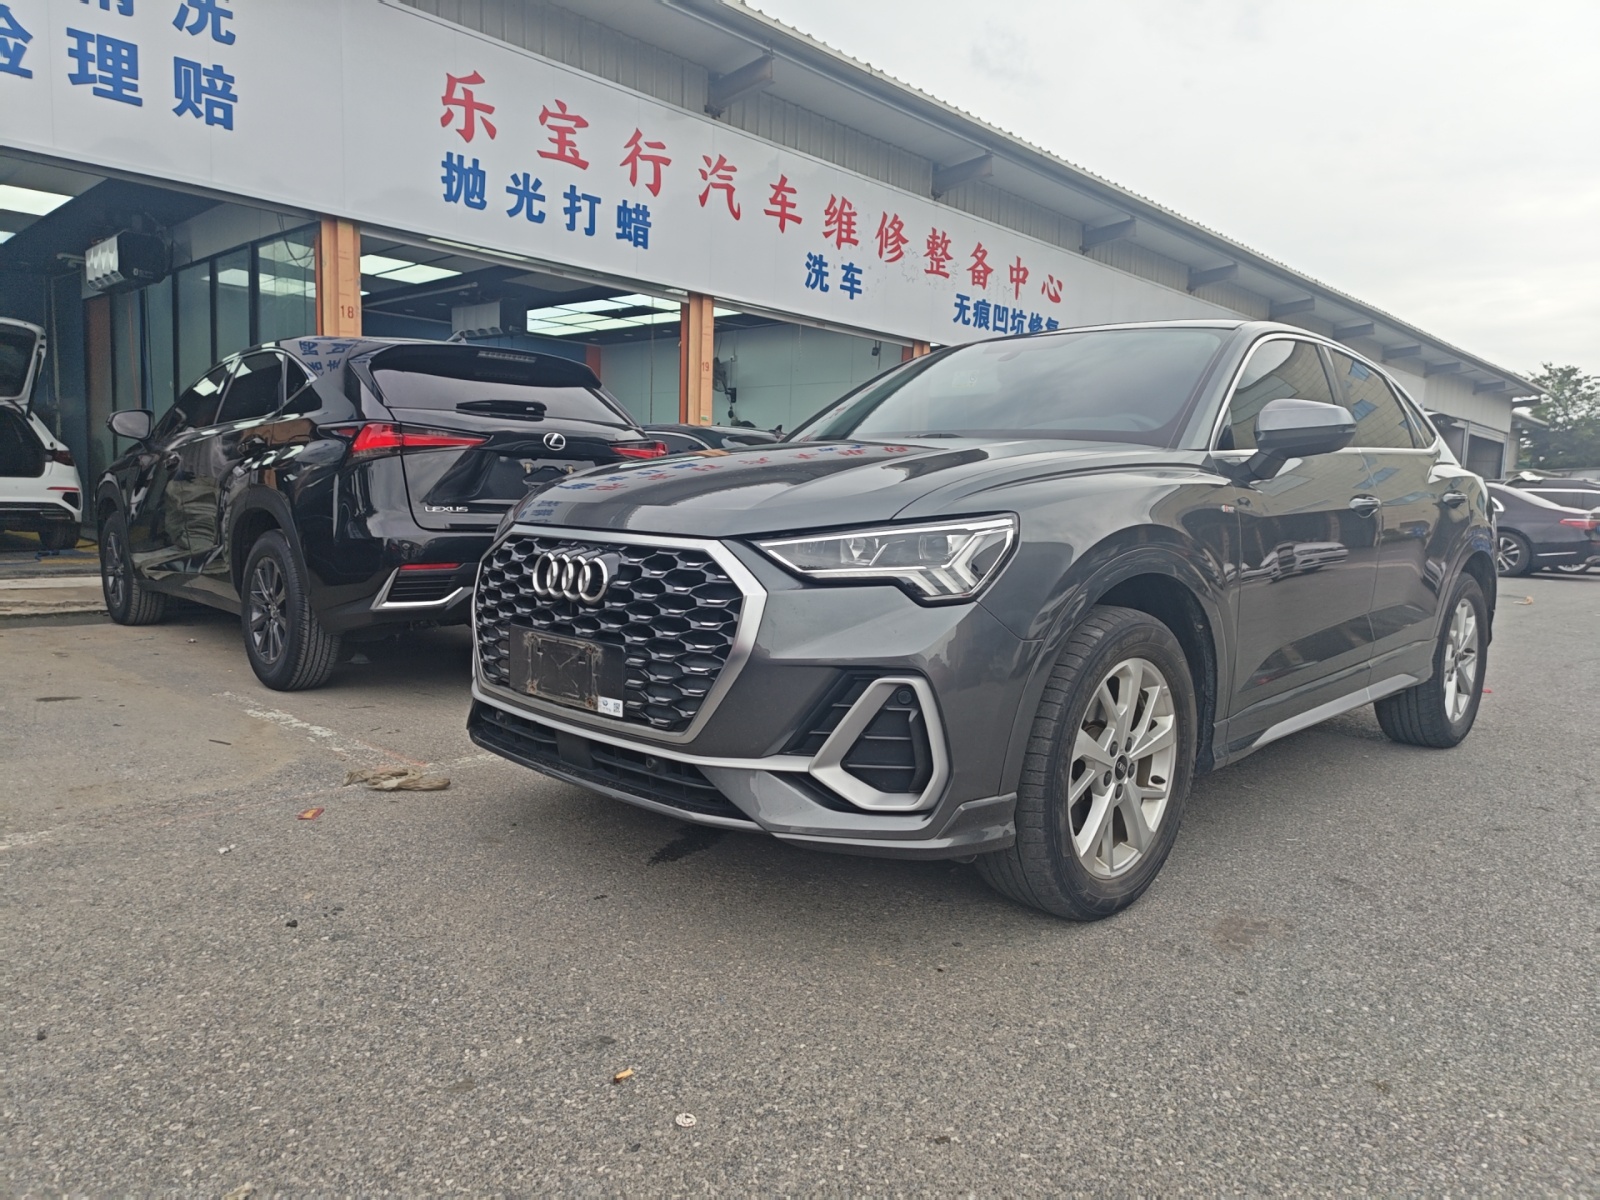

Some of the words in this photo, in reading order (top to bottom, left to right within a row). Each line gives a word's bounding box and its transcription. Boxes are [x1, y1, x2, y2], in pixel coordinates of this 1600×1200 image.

[440, 70, 1063, 304] 乐宝行汽车维修整备中心
[441, 151, 651, 250] 抛光打蜡
[804, 252, 863, 300] 洗车
[340, 305, 354, 319] 18
[702, 361, 710, 372] 19
[424, 505, 469, 513] LEXUS
